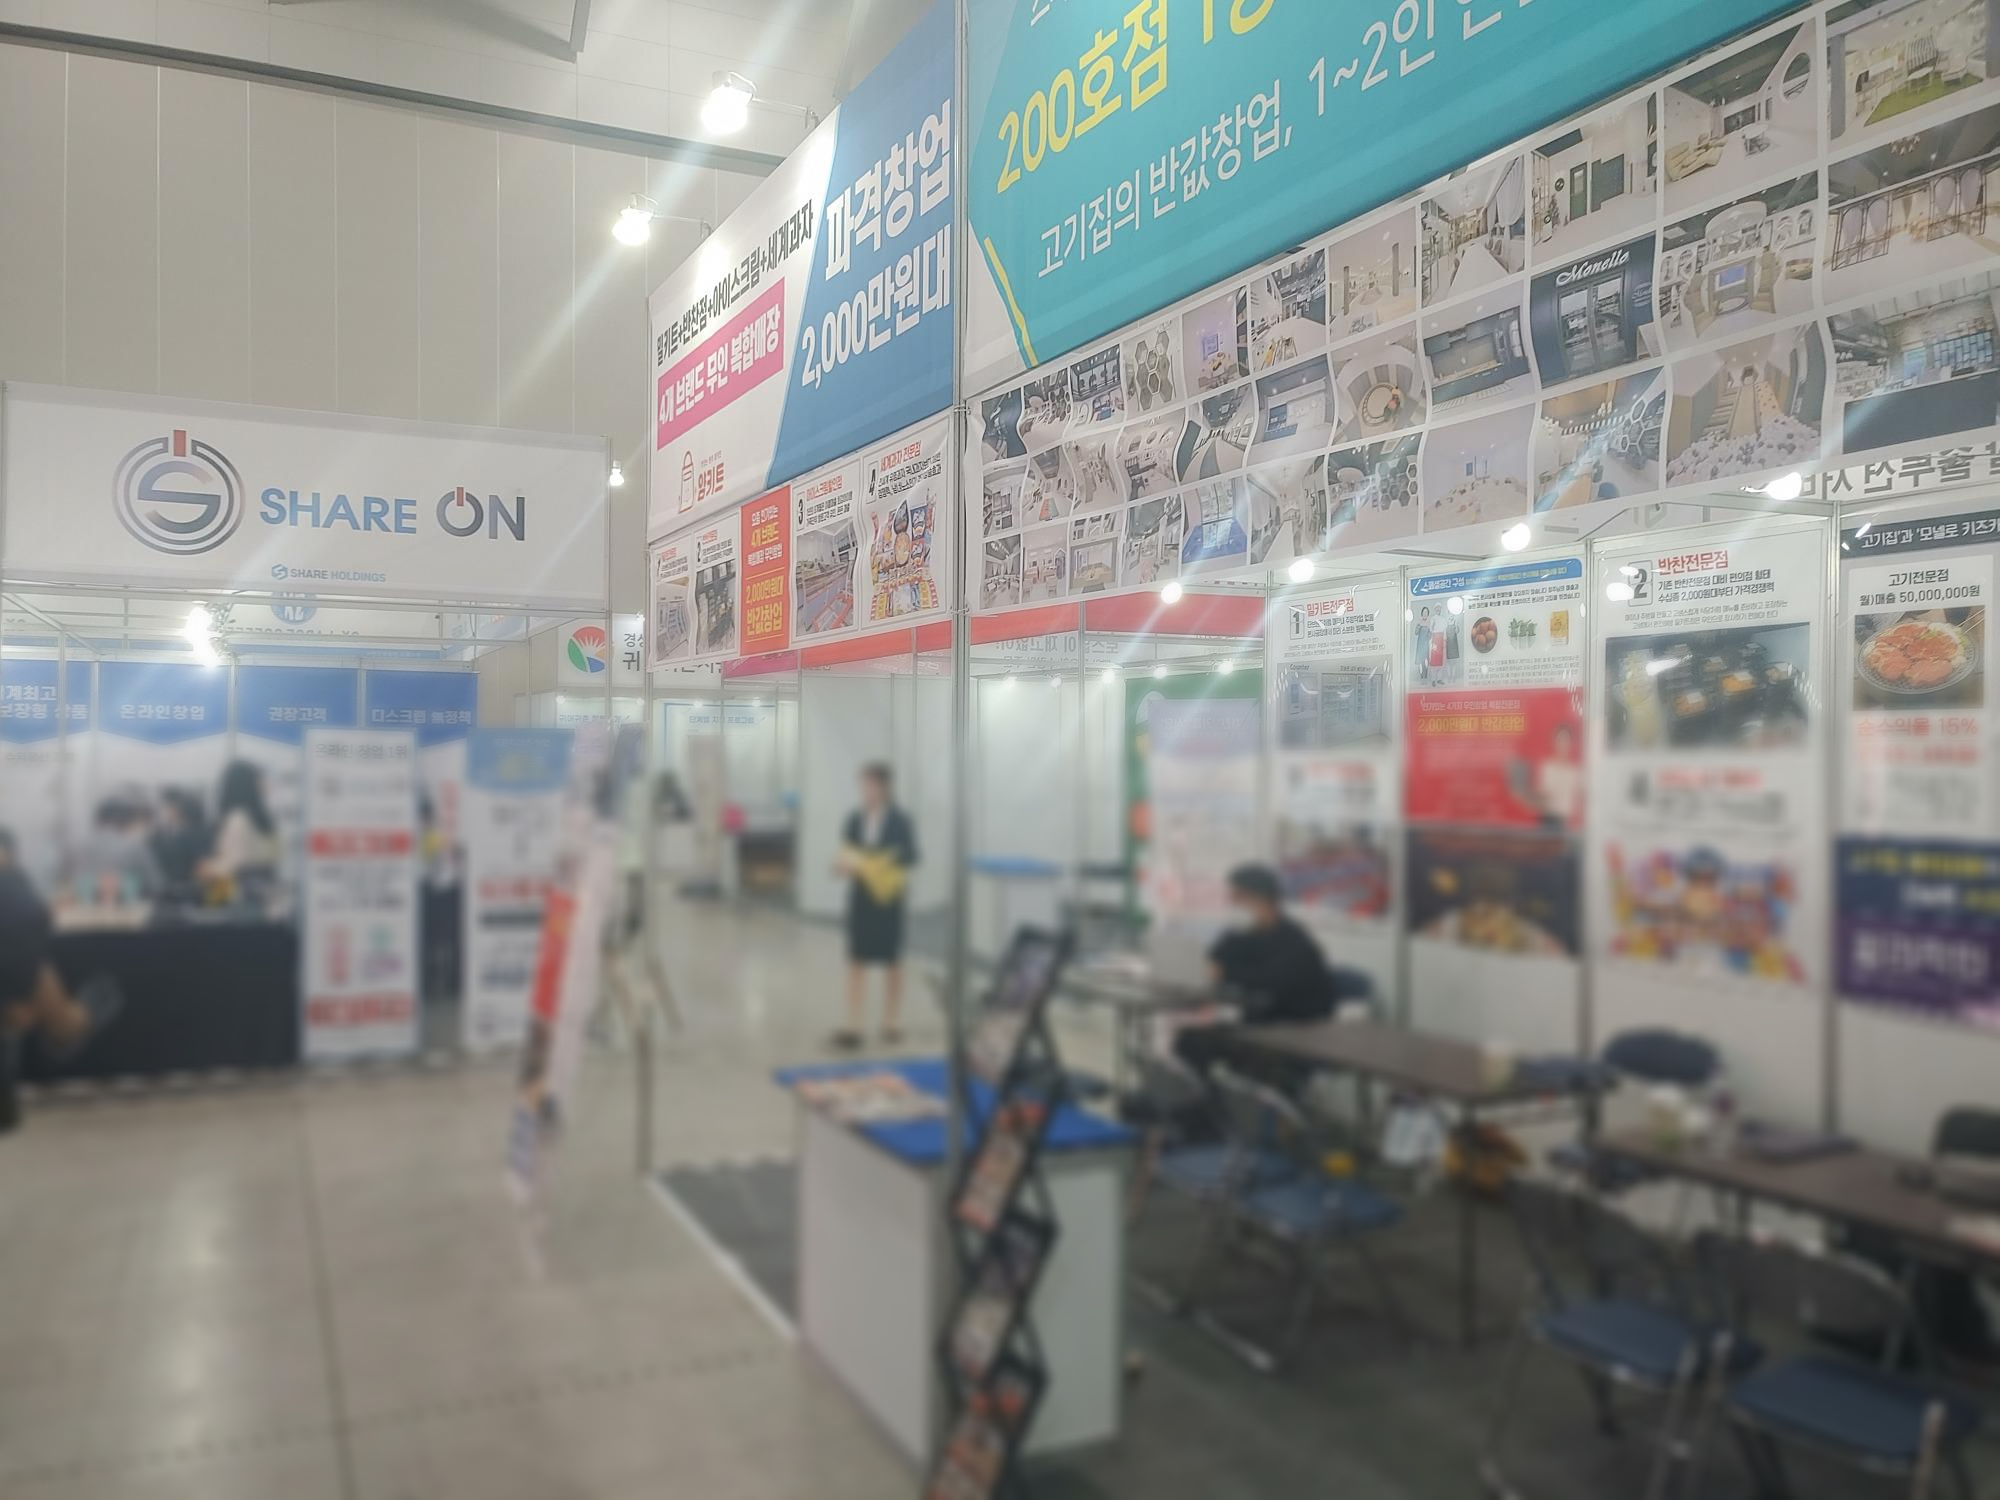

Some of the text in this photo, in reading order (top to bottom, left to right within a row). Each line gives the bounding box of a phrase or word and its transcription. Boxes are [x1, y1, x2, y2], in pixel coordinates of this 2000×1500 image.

[997, 0, 1167, 193] 200호점
[1038, 169, 1141, 279] 고기집의
[1149, 78, 1292, 218] 반값창업,
[1309, 0, 1435, 116] 1~2인
[825, 98, 949, 281] 파격창업
[1556, 249, 1630, 287] Monello
[802, 224, 950, 390] 2,000만원대
[707, 343, 728, 394] 무인
[730, 303, 780, 375] 복합매장
[259, 486, 526, 541] SHARE ON
[290, 568, 387, 583] SHARE HOLDINGS
[1658, 550, 1729, 576] 반찬전문점
[1634, 568, 1648, 599] 2
[1888, 568, 1949, 587] 고기전문점
[1900, 585, 1981, 603] 50,000,000원
[119, 704, 206, 721] 온라인창업
[268, 706, 327, 722] 권장고객
[1418, 716, 1479, 733] 2,000만원대
[1938, 717, 1978, 735] 15%
[315, 743, 353, 759] 온라인
[358, 744, 383, 760] 창업
